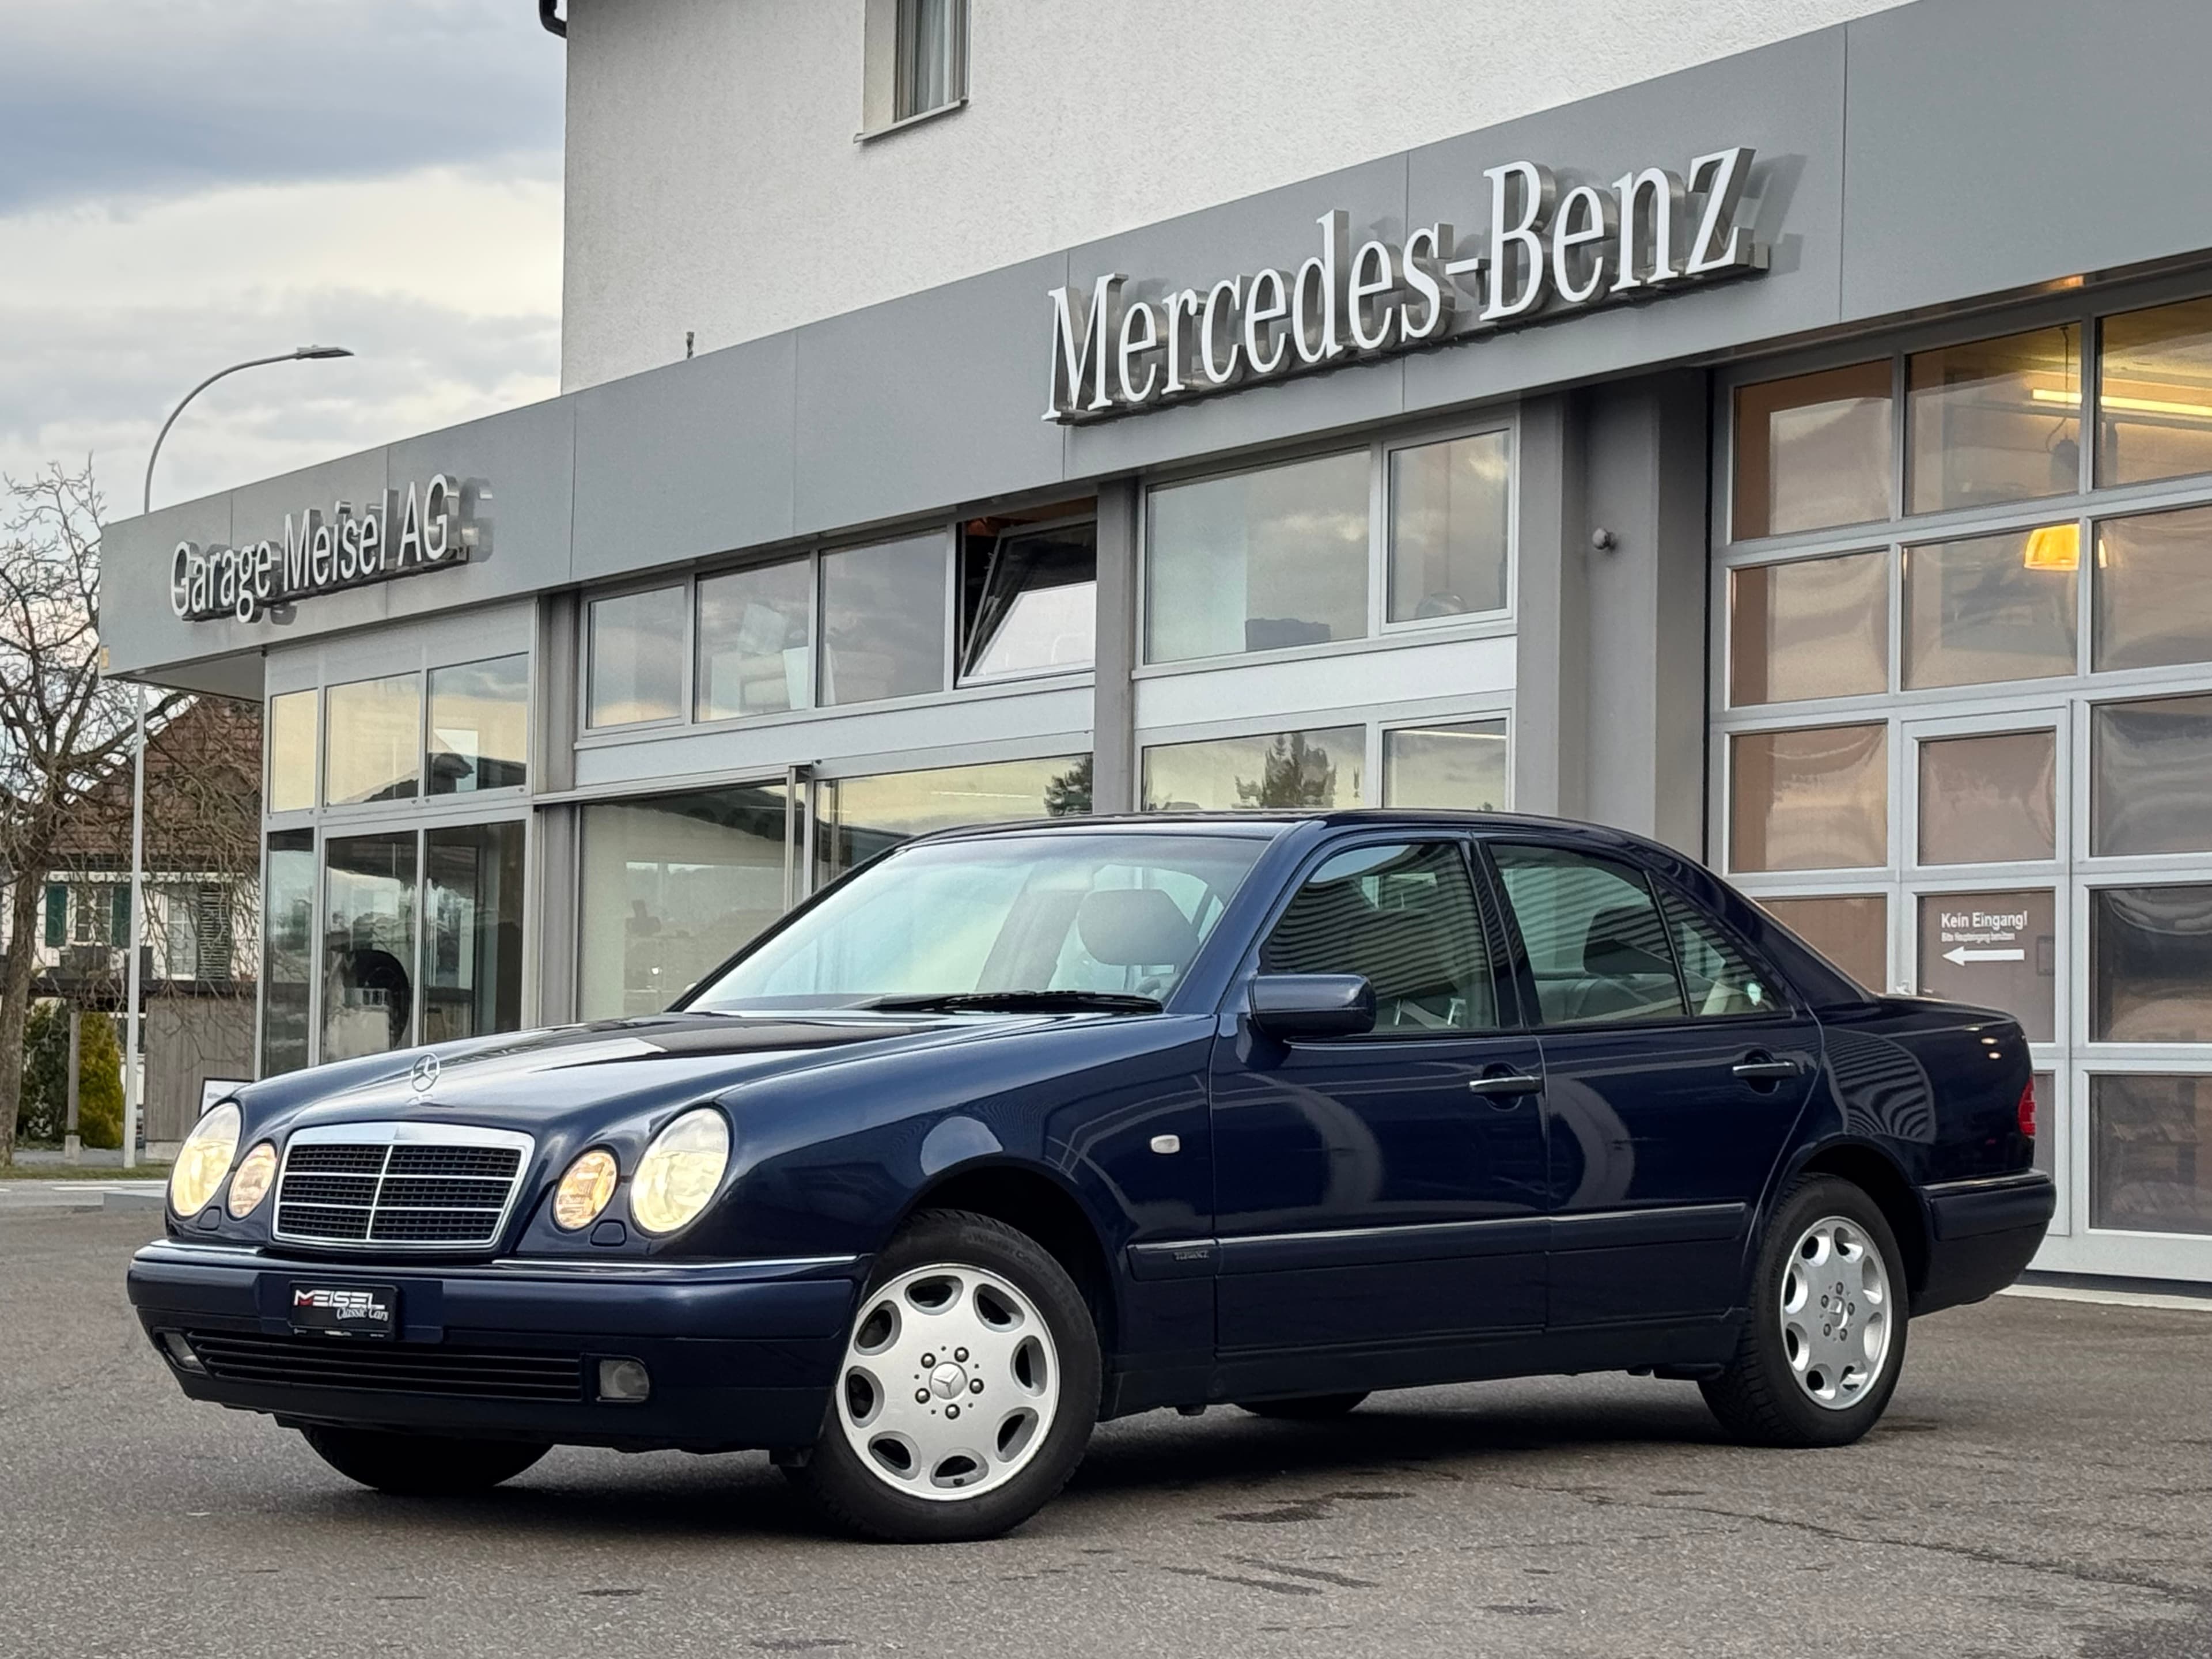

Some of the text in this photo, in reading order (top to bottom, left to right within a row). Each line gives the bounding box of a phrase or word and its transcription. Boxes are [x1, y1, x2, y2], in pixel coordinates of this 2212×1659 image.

[1041, 146, 1760, 423] Mercedes-Benz
[171, 473, 454, 623] Garage Meisel AG
[1941, 910, 2028, 931] Kein Eingang!
[293, 1289, 385, 1310] MEISEL
[336, 1306, 389, 1321] Classic Cars
